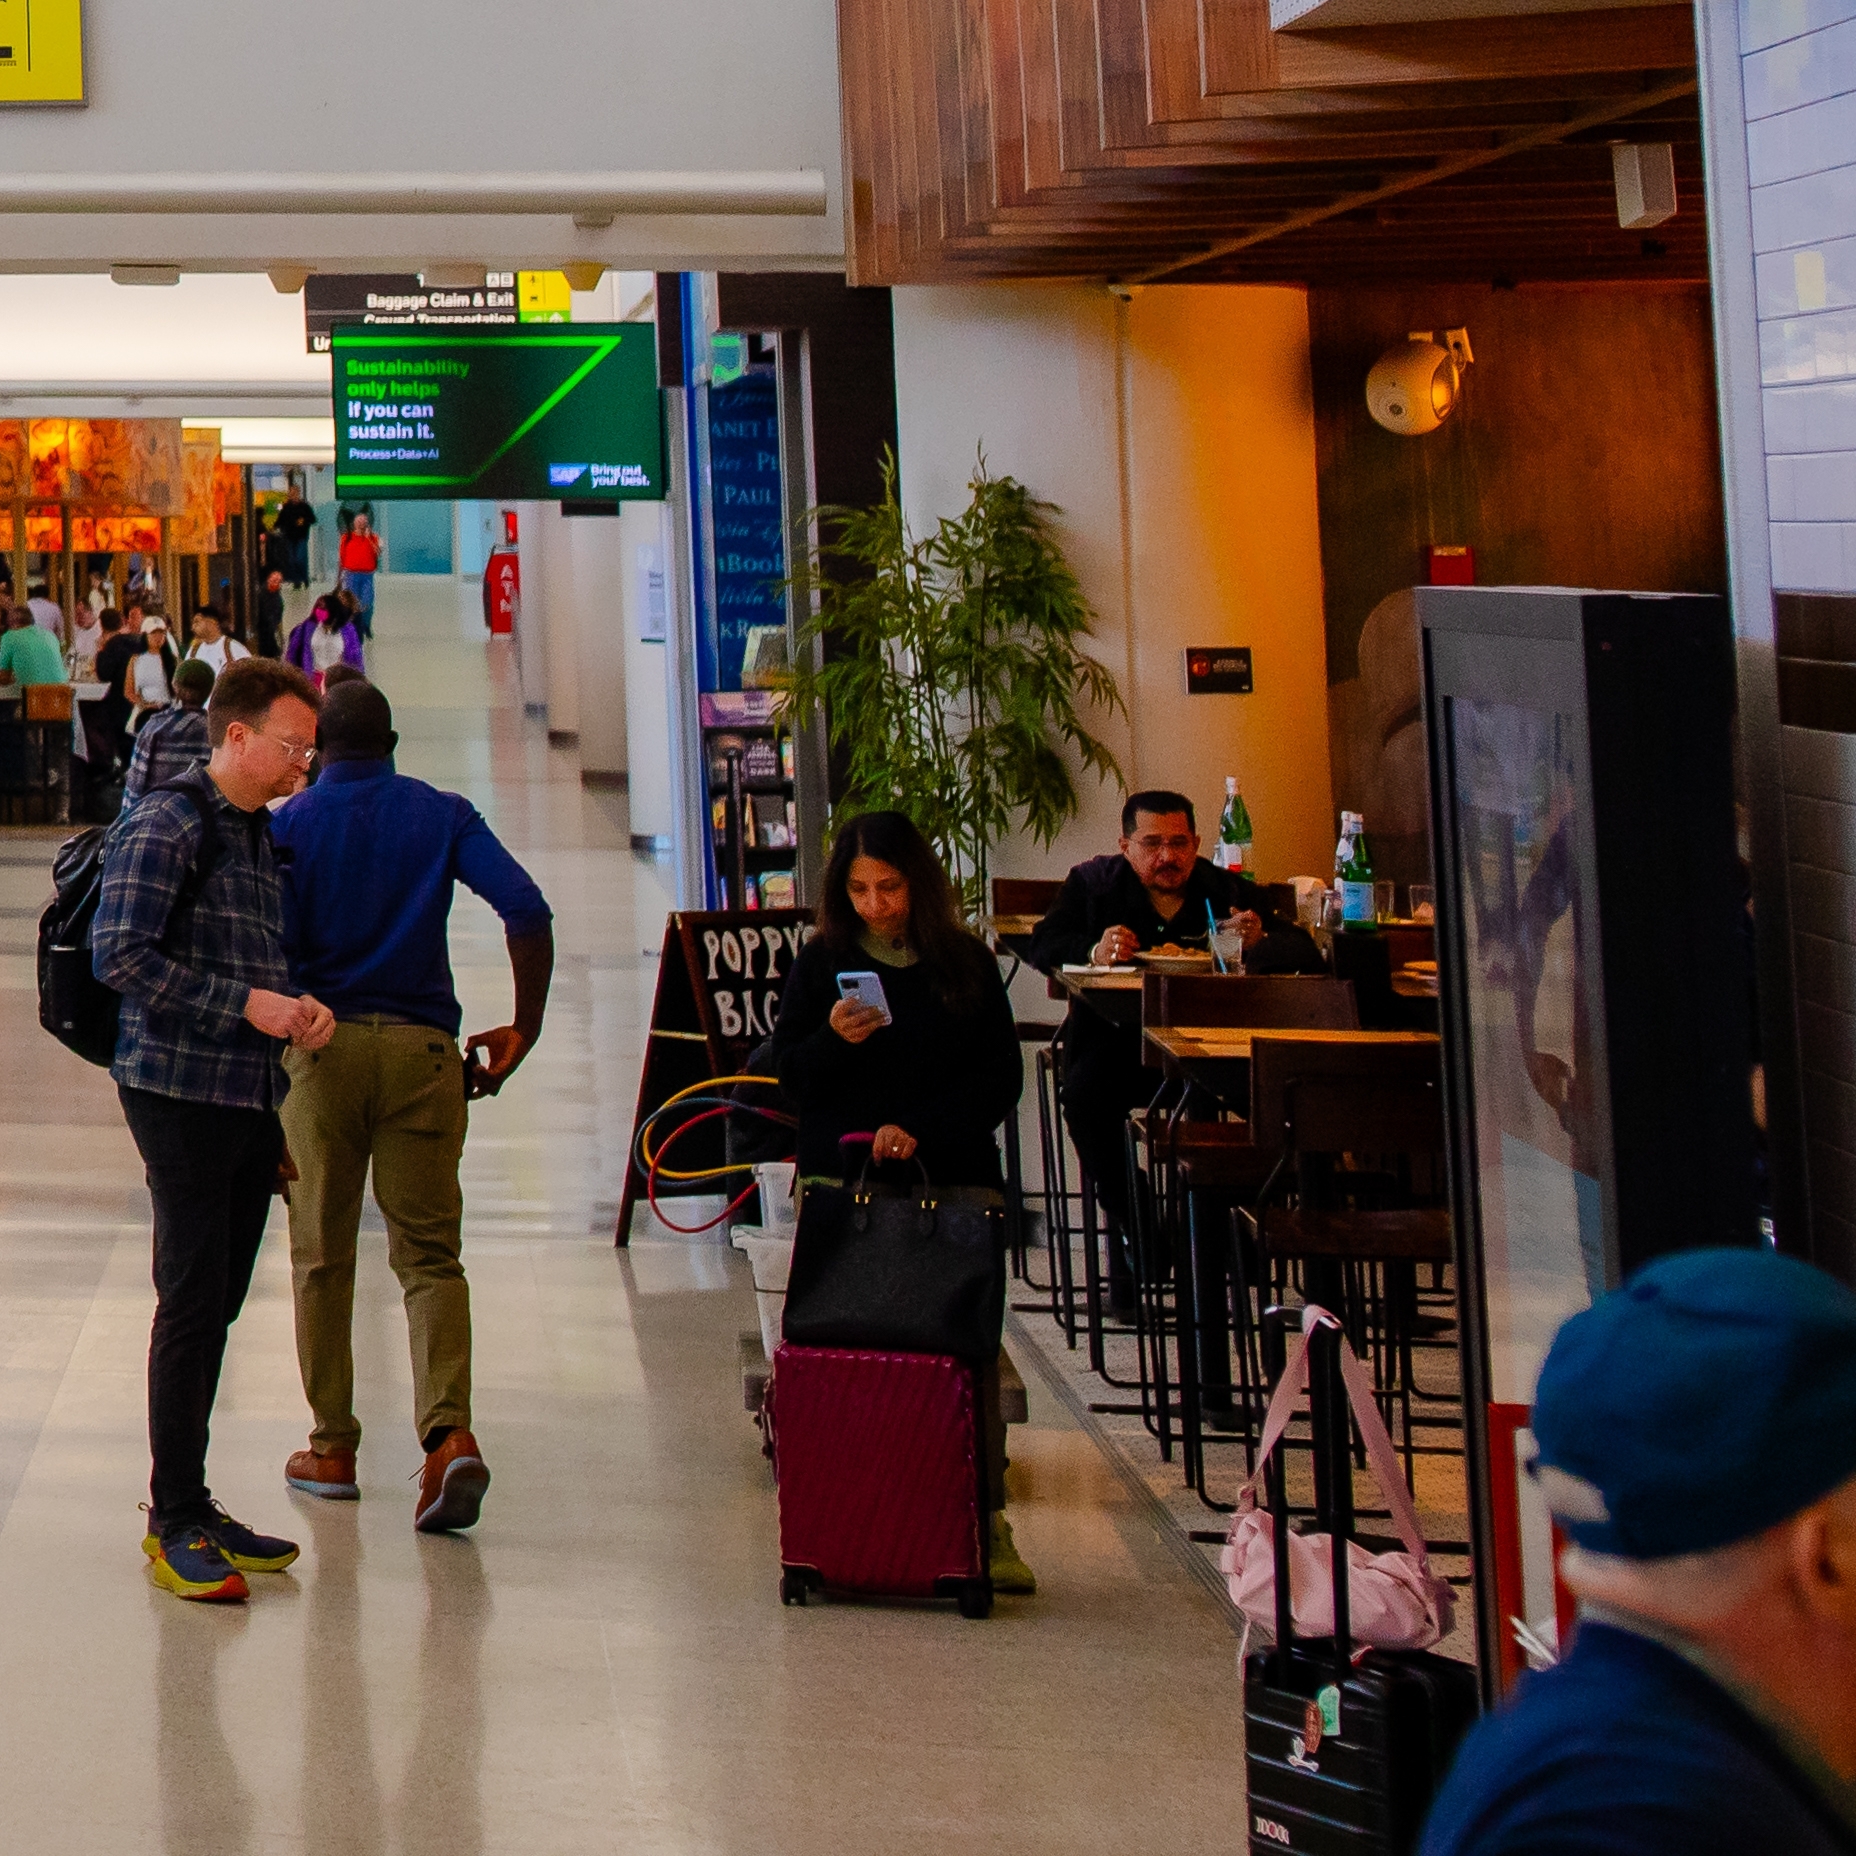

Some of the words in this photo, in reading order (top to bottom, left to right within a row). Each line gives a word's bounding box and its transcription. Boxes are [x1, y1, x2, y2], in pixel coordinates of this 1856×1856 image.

[367, 294, 427, 311] Baggage
[430, 293, 470, 308] Claim
[473, 293, 485, 308] &
[488, 292, 514, 308] Exit
[346, 359, 470, 379] Sustainability
[347, 381, 386, 400] only
[390, 380, 440, 399] helps
[364, 404, 397, 422] you
[401, 404, 433, 418] can
[348, 424, 413, 440] sustain
[417, 424, 435, 440] it.
[714, 990, 781, 1037] BAG
